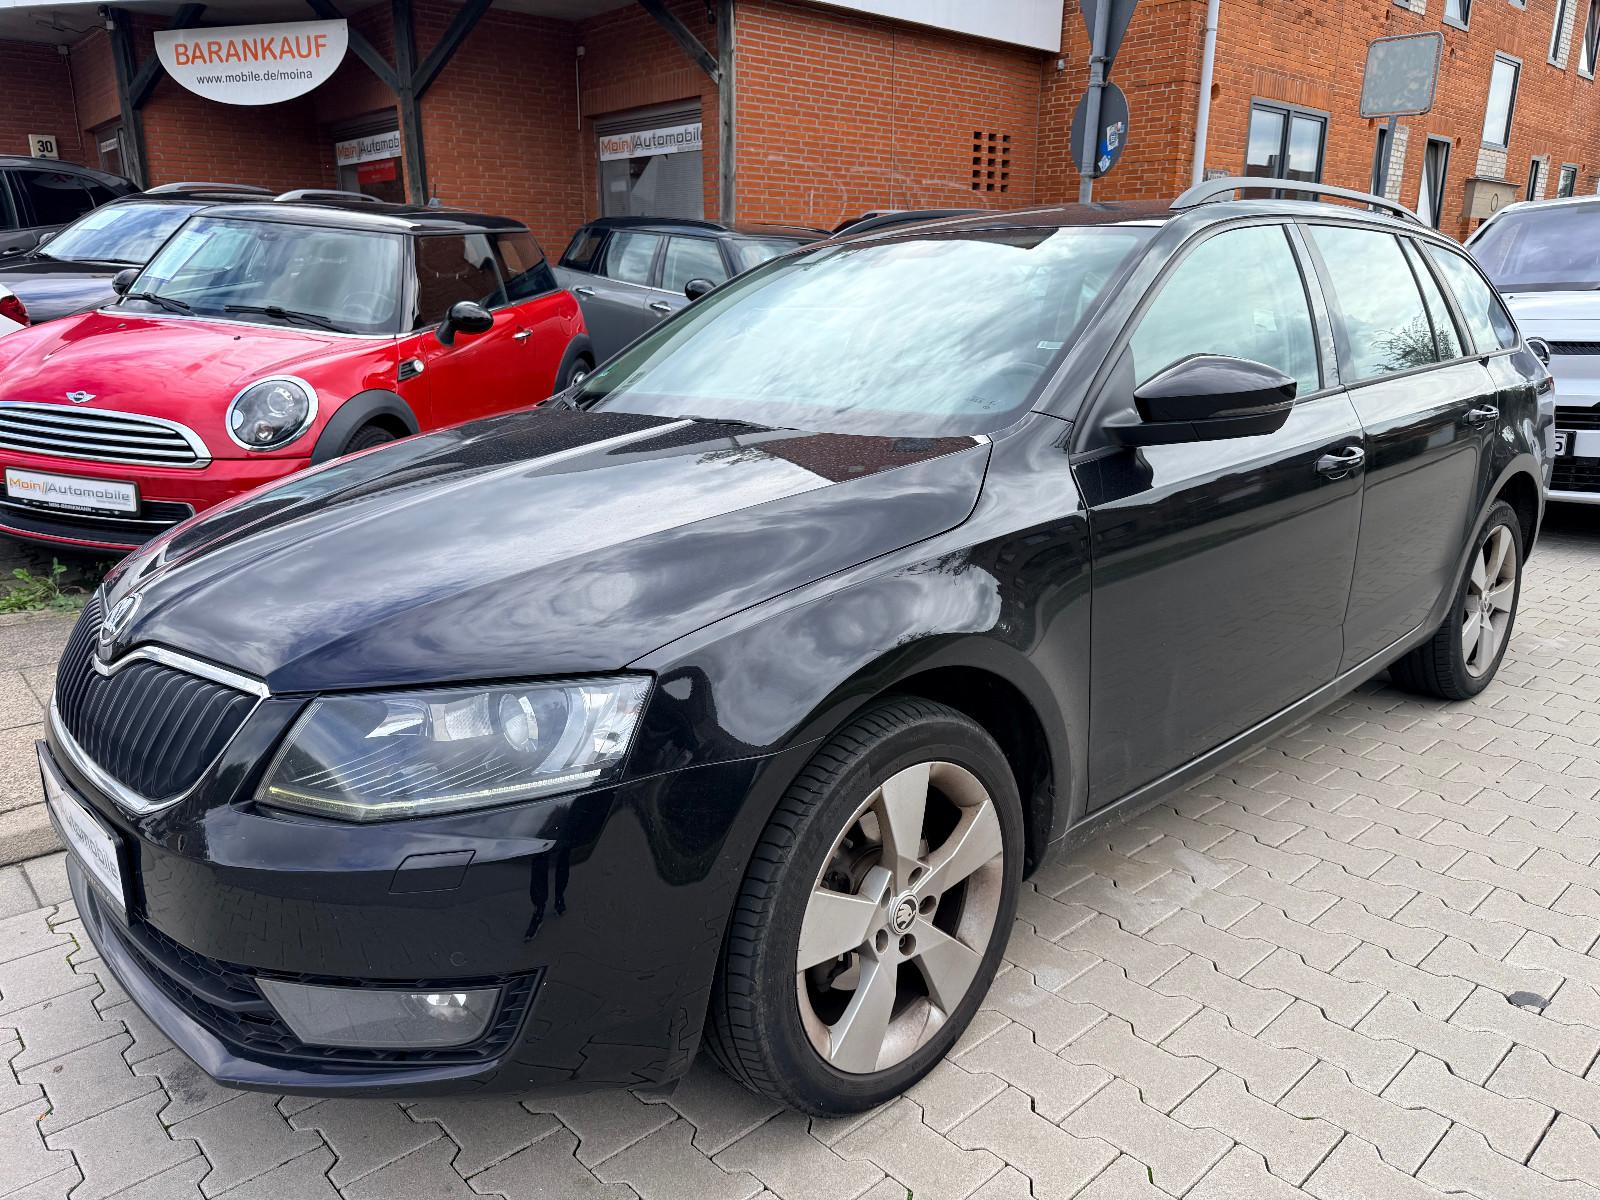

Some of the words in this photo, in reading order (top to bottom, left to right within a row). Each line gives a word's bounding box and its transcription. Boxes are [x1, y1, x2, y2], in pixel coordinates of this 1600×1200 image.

[174, 34, 327, 66] BARANKAUF
[196, 68, 313, 85] www.mobile.de/moina
[37, 140, 53, 153] 30
